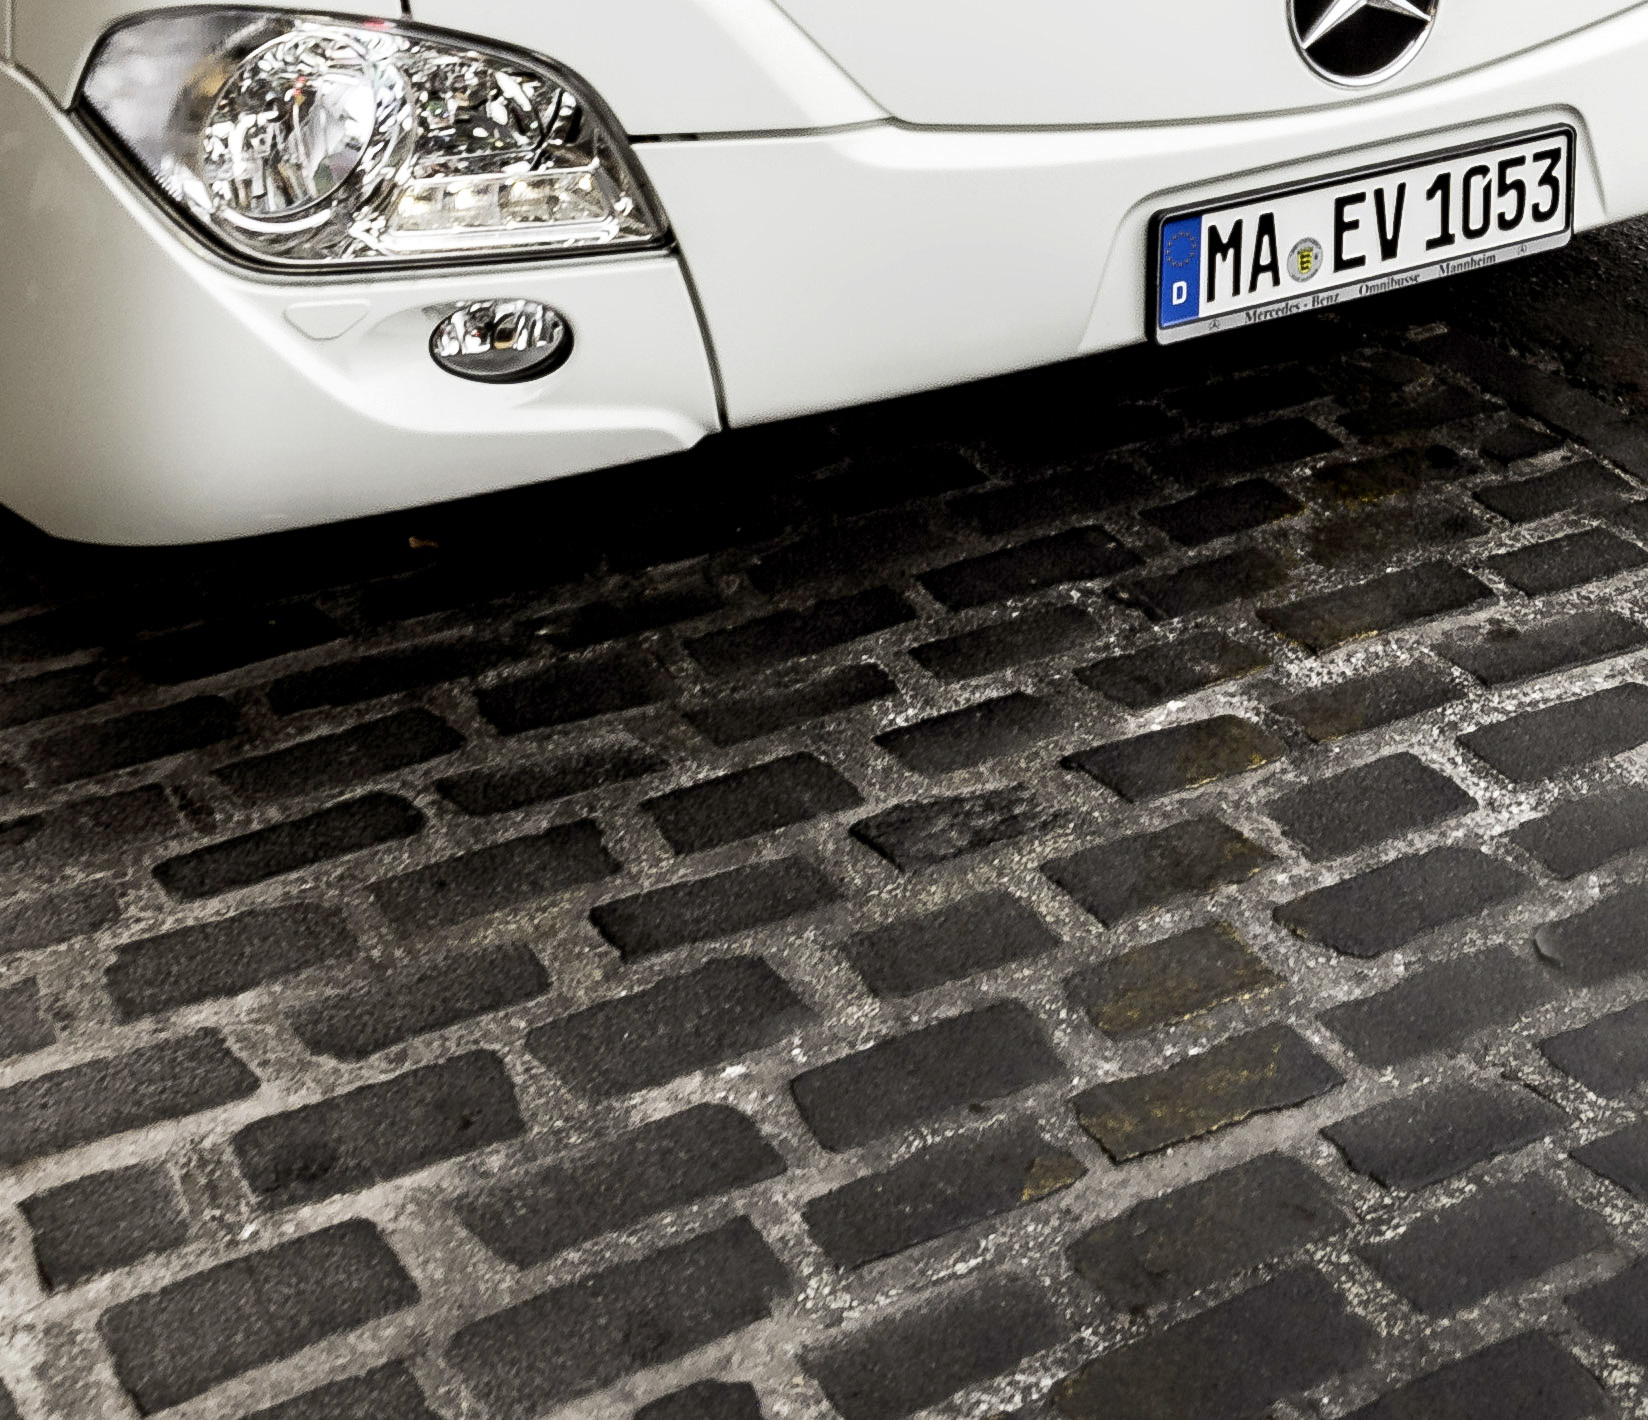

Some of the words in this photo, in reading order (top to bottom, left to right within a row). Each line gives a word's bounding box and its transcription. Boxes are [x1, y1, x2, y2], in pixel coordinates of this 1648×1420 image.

[1171, 281, 1188, 306] D
[1206, 211, 1281, 304] MA
[1332, 182, 1407, 275] EV
[1425, 147, 1563, 251] 1053
[1311, 292, 1341, 310] Benz
[1438, 253, 1498, 277] Mannheim
